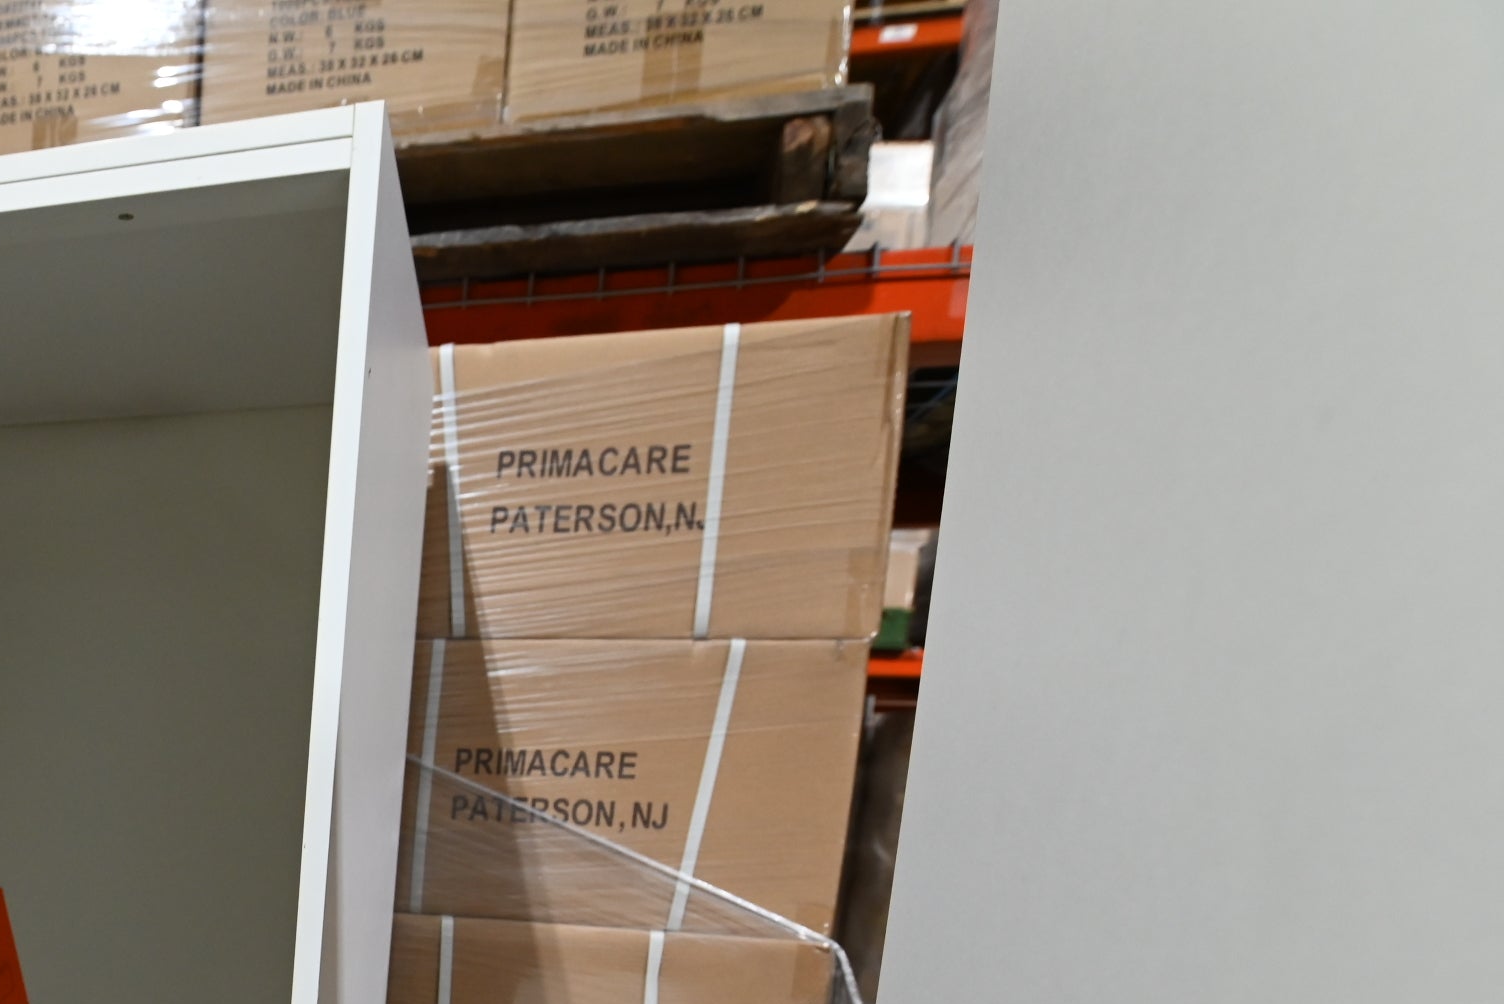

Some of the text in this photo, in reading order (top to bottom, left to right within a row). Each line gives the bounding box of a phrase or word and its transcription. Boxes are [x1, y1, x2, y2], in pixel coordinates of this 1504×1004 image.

[737, 4, 764, 21] CM
[354, 18, 385, 33] KGS
[353, 36, 385, 50] KGS
[583, 30, 704, 57] MADE IN CHINA
[337, 57, 346, 71] X
[370, 54, 379, 67] X
[400, 48, 424, 63] CM
[100, 82, 121, 96] CM
[265, 72, 372, 96] MADE IN CHINA
[20, 110, 32, 122] IN
[35, 104, 75, 119] CHINA
[496, 444, 692, 479] PRIMACARE
[454, 747, 639, 780] PRIMACARE
